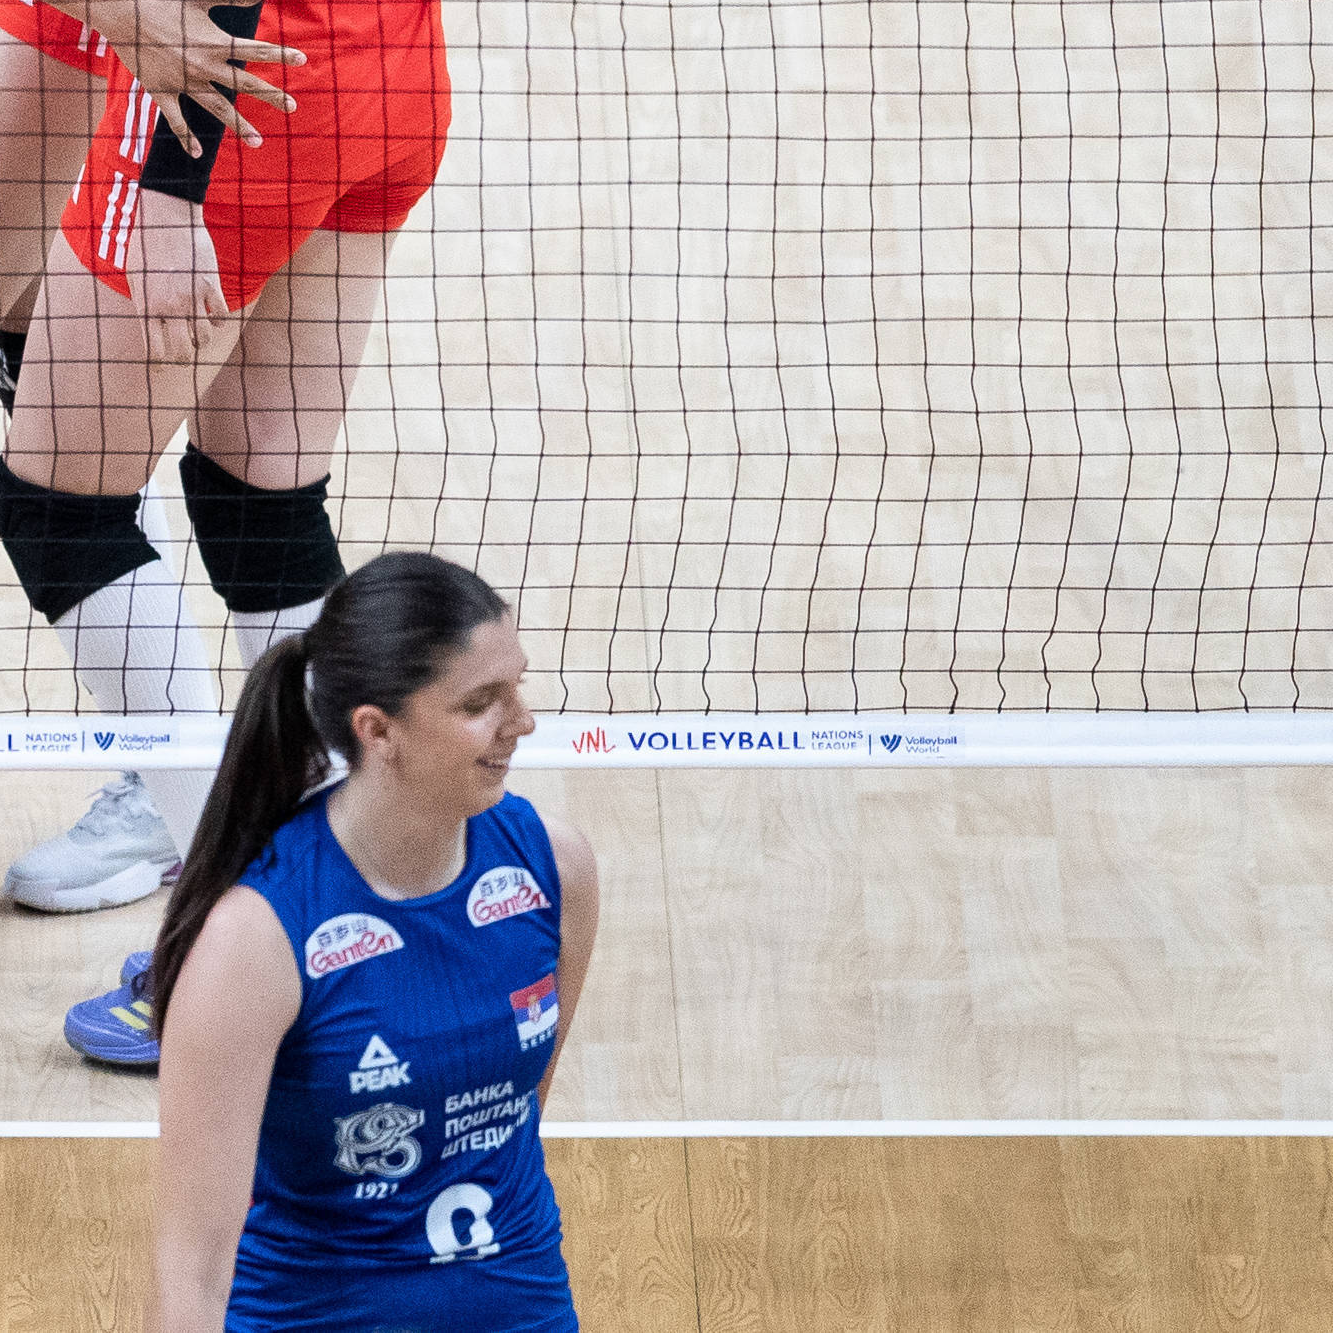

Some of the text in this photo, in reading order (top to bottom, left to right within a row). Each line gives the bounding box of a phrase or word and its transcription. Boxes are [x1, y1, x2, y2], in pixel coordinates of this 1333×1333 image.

[25, 733, 77, 742] NATIONS
[118, 733, 170, 745] Volleyball
[572, 727, 805, 753] VNL VOLLEYBALL
[811, 730, 864, 740] NATIONS
[905, 735, 957, 746] Volleyball
[349, 1061, 412, 1094] PEAK
[445, 1080, 514, 1114] БАНКА
[445, 1090, 534, 1139] ПОШТАН
[441, 1113, 523, 1159] ШТЕДИ
